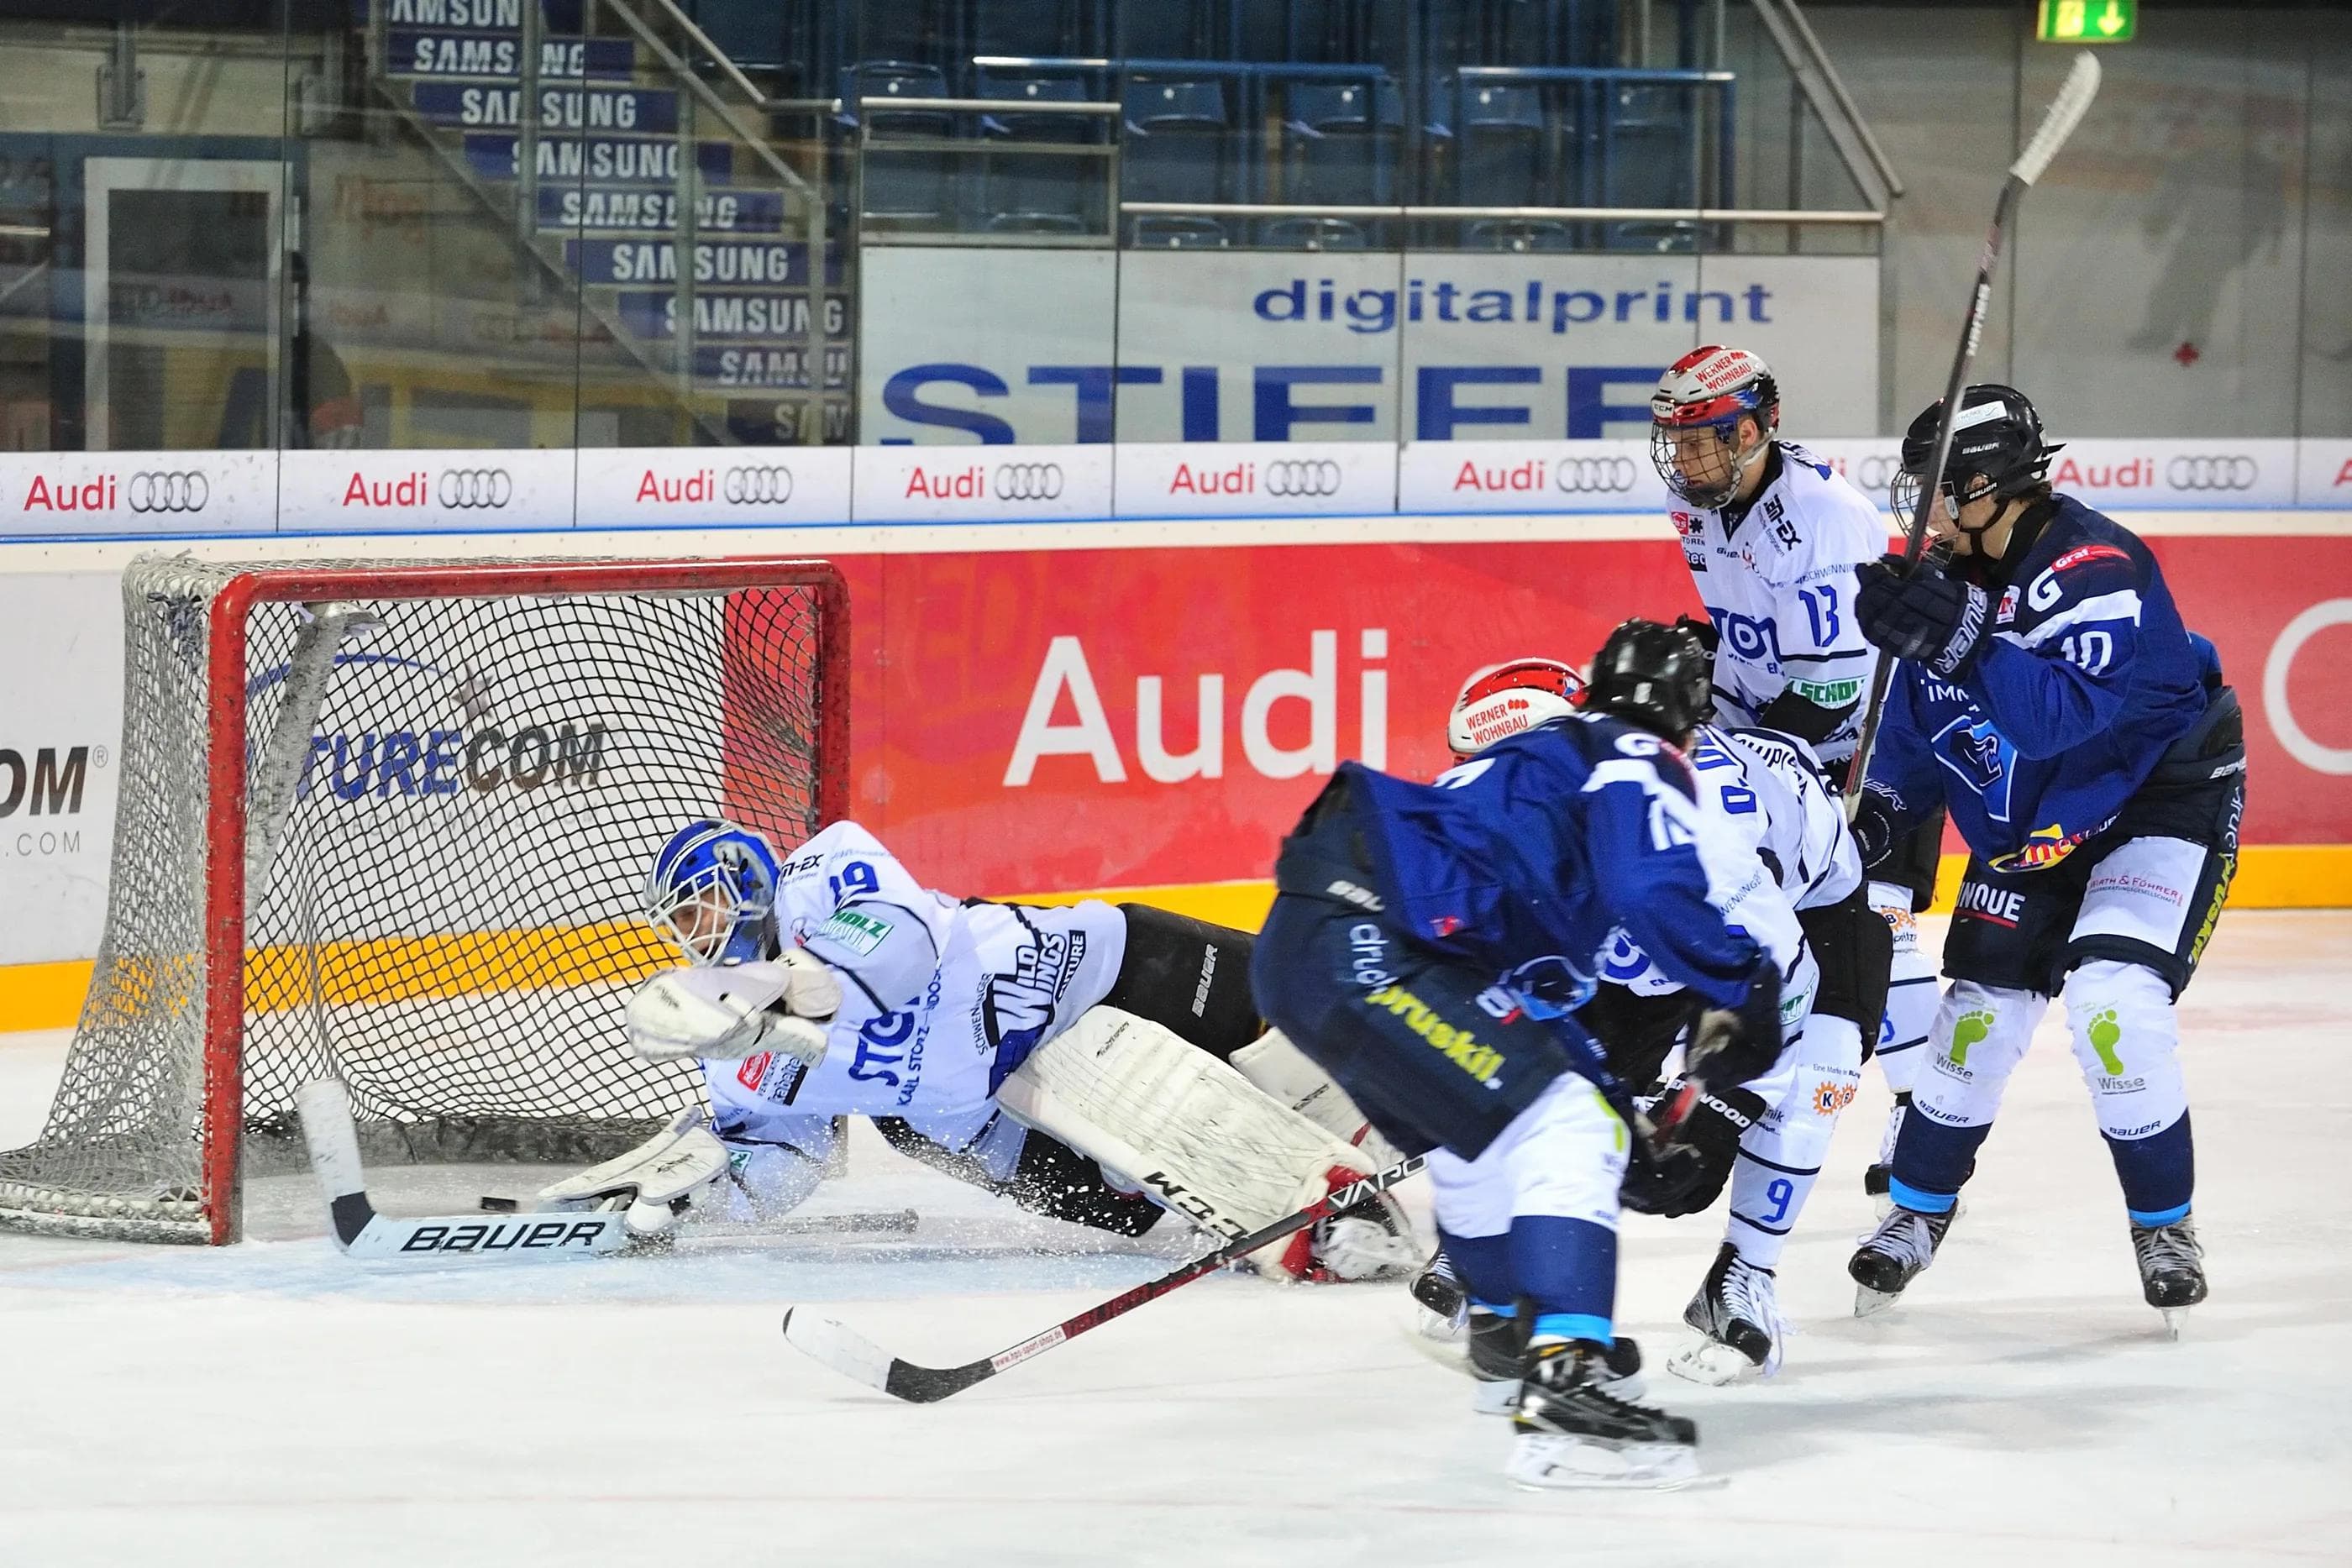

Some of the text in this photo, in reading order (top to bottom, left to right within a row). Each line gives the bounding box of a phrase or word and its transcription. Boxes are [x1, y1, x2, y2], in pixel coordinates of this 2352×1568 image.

[413, 38, 585, 74] SAMSNG
[1252, 279, 1772, 333] digitalprint
[717, 350, 848, 386] SAMU
[1694, 355, 1734, 383] WERNER
[1705, 362, 1752, 393] WOHNBAU
[1653, 403, 1672, 412] CCM
[343, 471, 428, 506] Audi
[636, 468, 715, 503] Audi
[906, 464, 984, 500] Audi
[1169, 461, 1255, 496] Audi
[1454, 459, 1545, 492] Audi
[2055, 458, 2154, 488] Audi
[24, 475, 116, 511] Audi
[1798, 584, 1840, 648] 13
[1002, 628, 1388, 787] Audi
[1466, 704, 1509, 731] WERNER
[1473, 713, 1529, 746] WOHNBAU
[1190, 942, 1219, 1019] BAUER
[1935, 1051, 1974, 1080] Wisse
[2097, 1077, 2146, 1091] Wisse
[2109, 1120, 2162, 1137] BAUER
[1143, 1171, 1250, 1240] CCM
[1759, 1177, 1795, 1224] 9
[400, 1220, 606, 1252] BAUER
